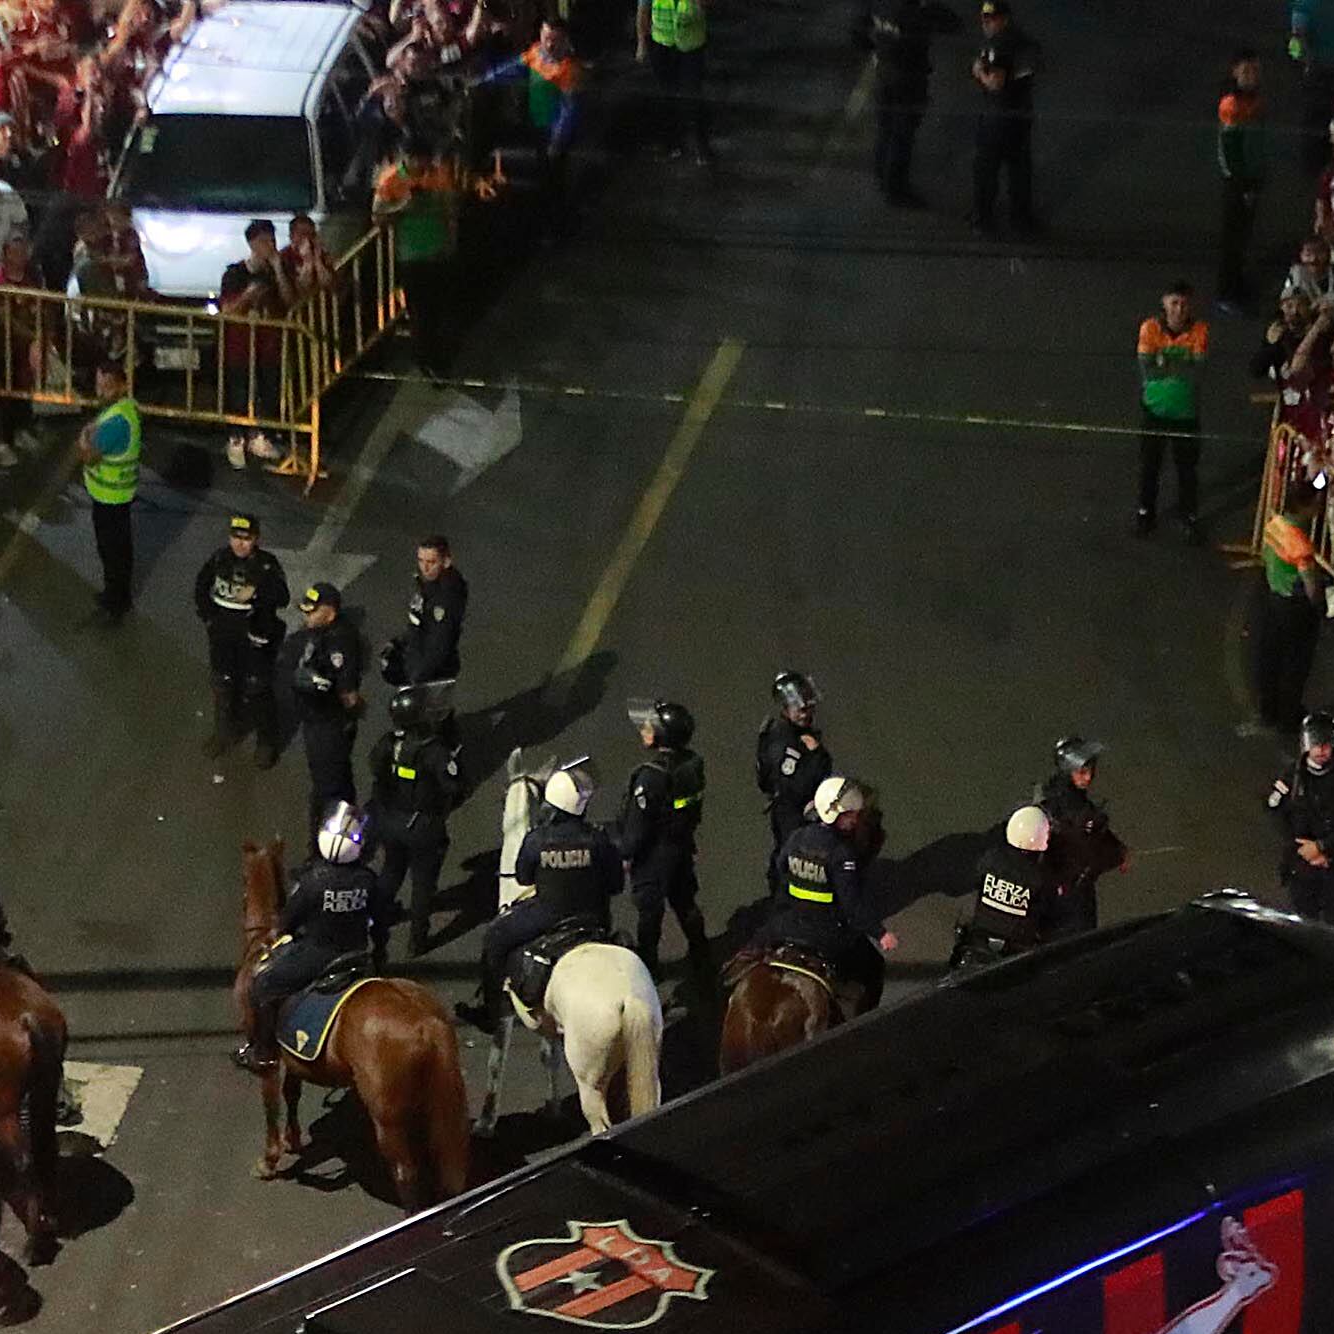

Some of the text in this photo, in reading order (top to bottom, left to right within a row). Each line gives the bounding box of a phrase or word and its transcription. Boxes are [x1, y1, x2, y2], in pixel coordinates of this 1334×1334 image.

[323, 888, 368, 901] FUERZA
[982, 884, 1029, 910] PUBLICA
[985, 872, 1031, 901] FUERZA
[595, 1235, 673, 1284] LDA
